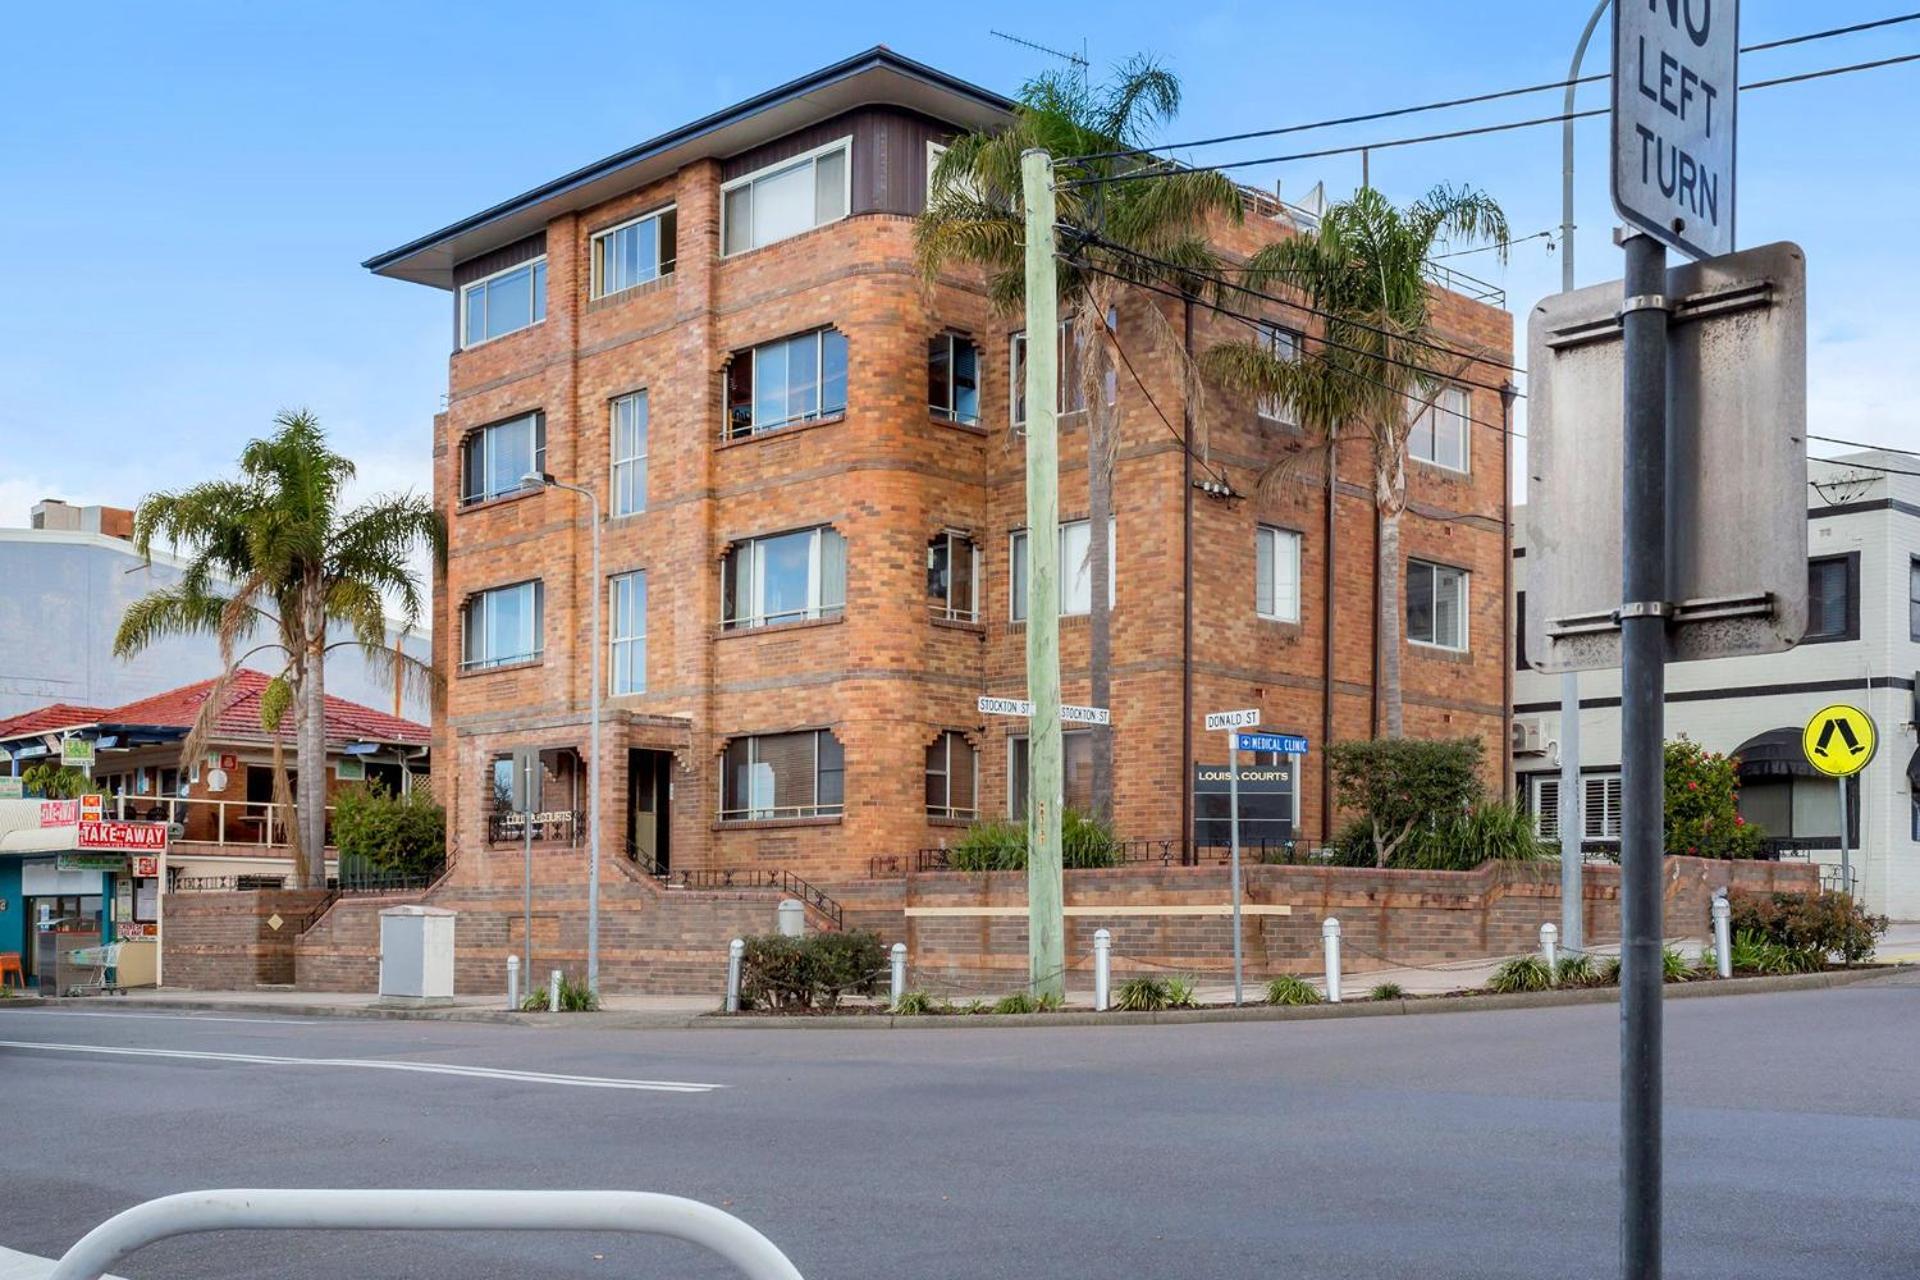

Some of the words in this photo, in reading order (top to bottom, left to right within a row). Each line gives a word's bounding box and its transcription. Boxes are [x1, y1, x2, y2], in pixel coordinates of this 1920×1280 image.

[1639, 35, 1717, 138] LEFT
[1636, 122, 1717, 226] TURN
[980, 698, 1018, 713] STOCKTON
[1022, 703, 1030, 714] ST
[1062, 707, 1096, 720] STOCKTON
[1100, 711, 1108, 721] ST
[1208, 713, 1241, 728] DONALD
[1246, 712, 1257, 724] ST
[1251, 736, 1281, 751] MEDICAL
[1284, 738, 1307, 752] CLINIC
[1241, 771, 1288, 781] COURTS
[125, 827, 163, 843] AWAY
